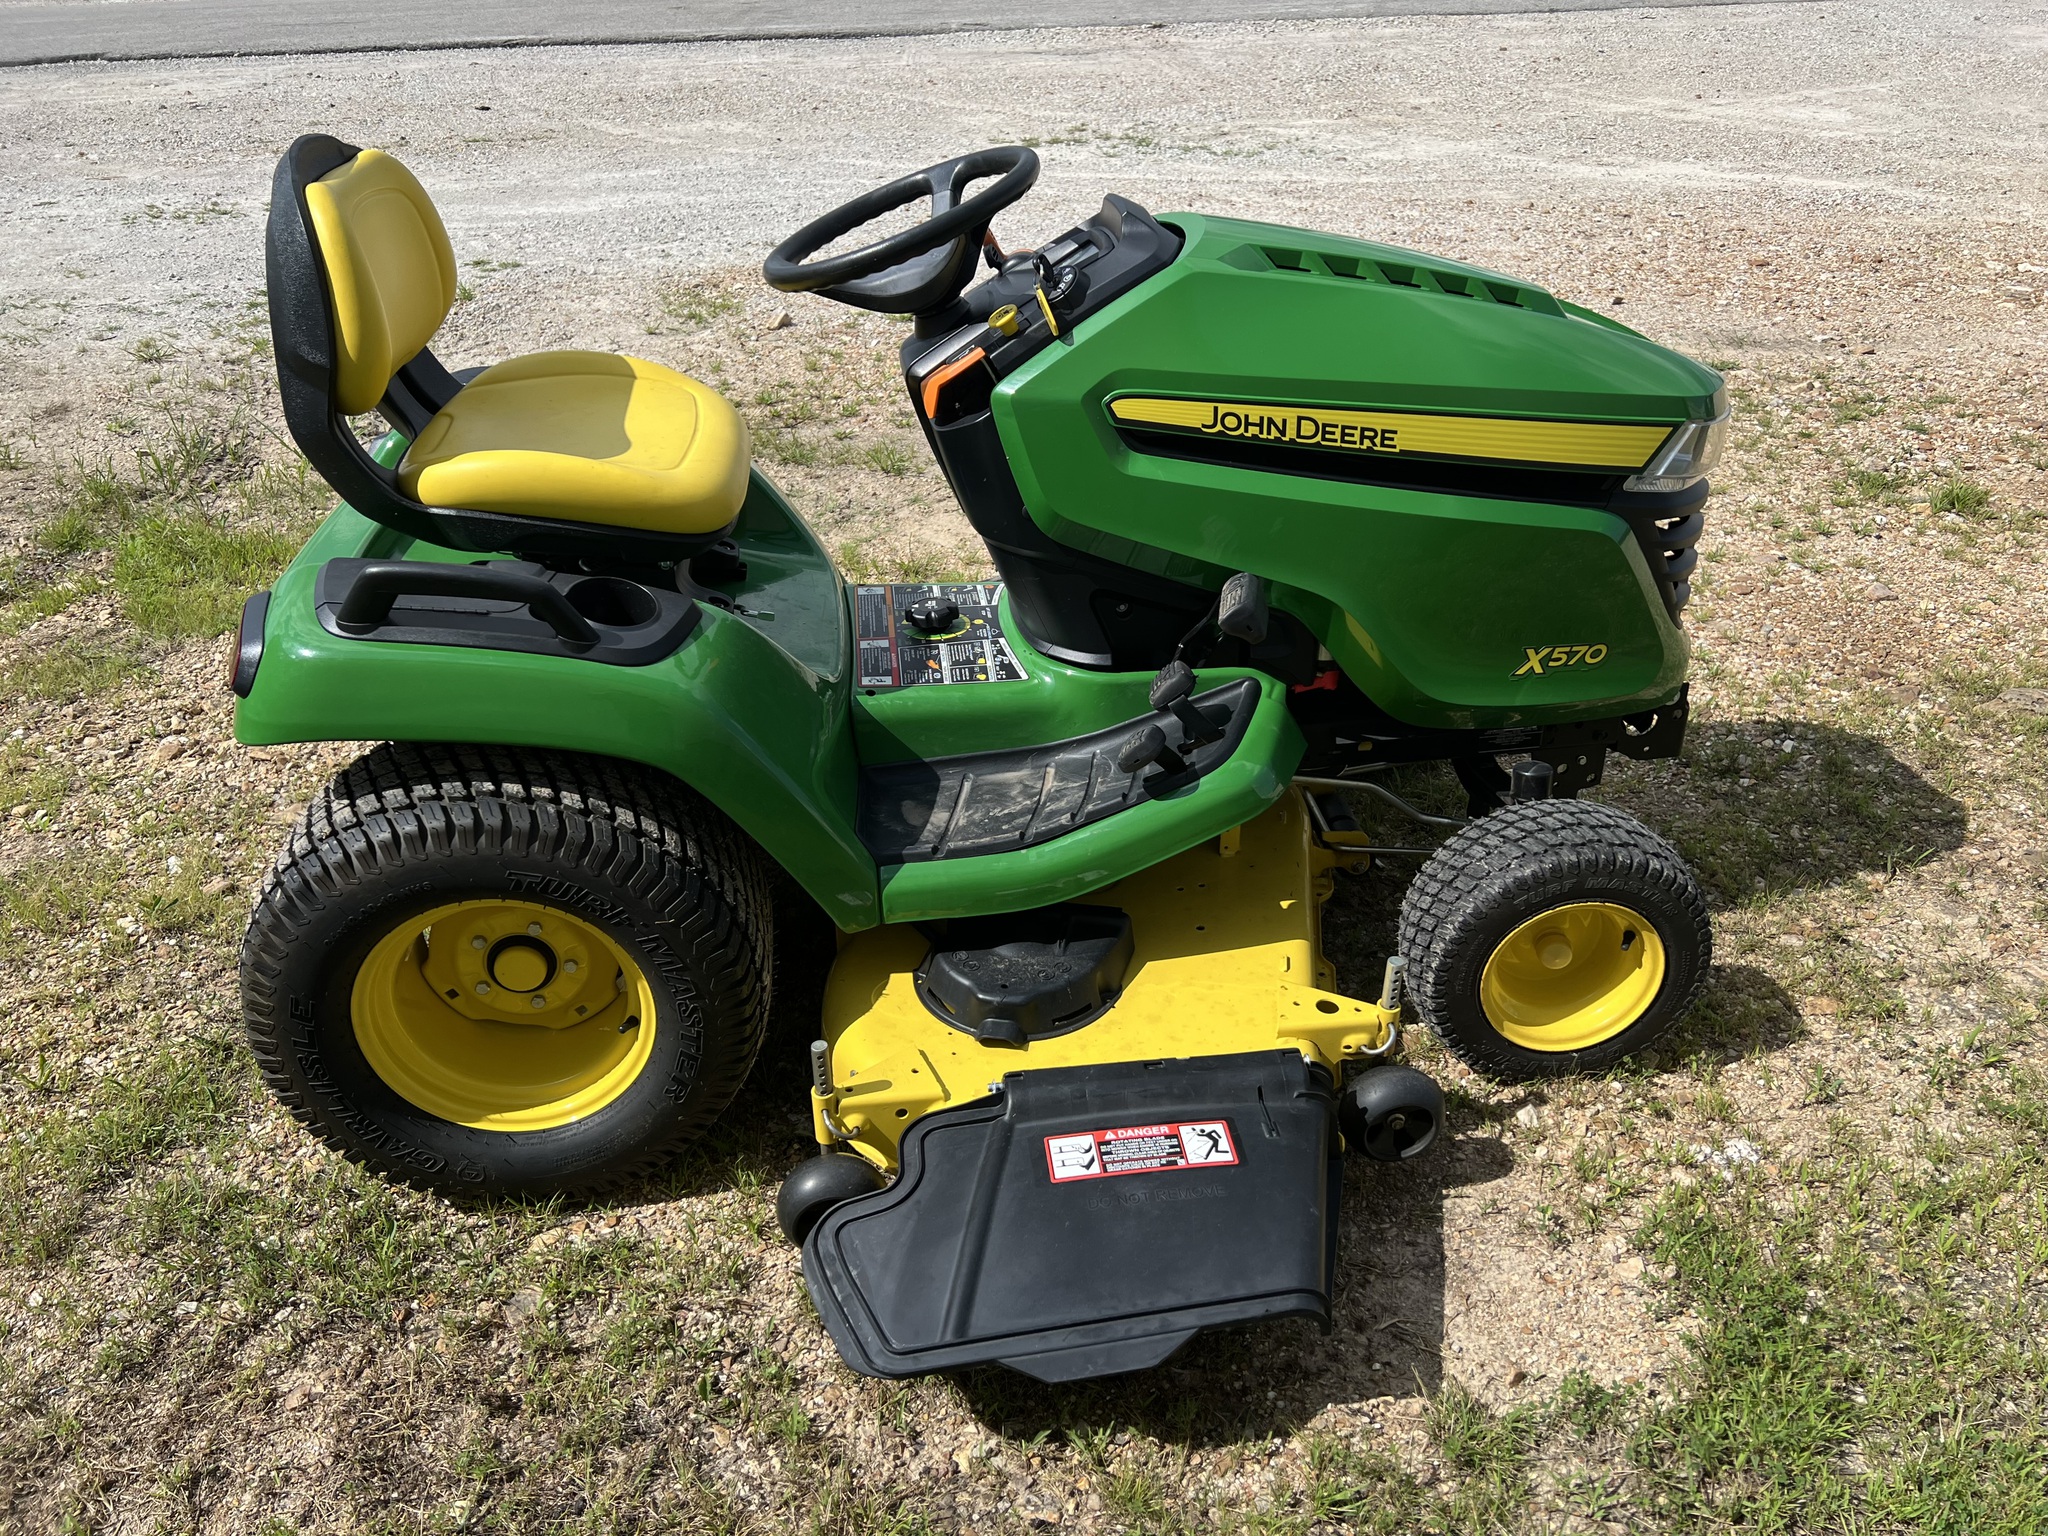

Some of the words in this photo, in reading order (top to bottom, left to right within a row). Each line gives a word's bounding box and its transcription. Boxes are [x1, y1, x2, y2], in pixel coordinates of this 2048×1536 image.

[1201, 404, 1288, 440] JOHN
[1296, 415, 1399, 451] DEERE
[1513, 643, 1608, 676] X570
[1513, 878, 1577, 910] TURF
[1584, 876, 1679, 918] MASTER
[504, 869, 636, 929] TURF
[635, 930, 705, 1106] MASTER
[290, 992, 450, 1176] CARLISLE
[1117, 1126, 1169, 1138] DANGER
[1087, 1197, 1110, 1211] DO
[1117, 1192, 1150, 1206] NOT
[1155, 1185, 1227, 1201] REMOVE
